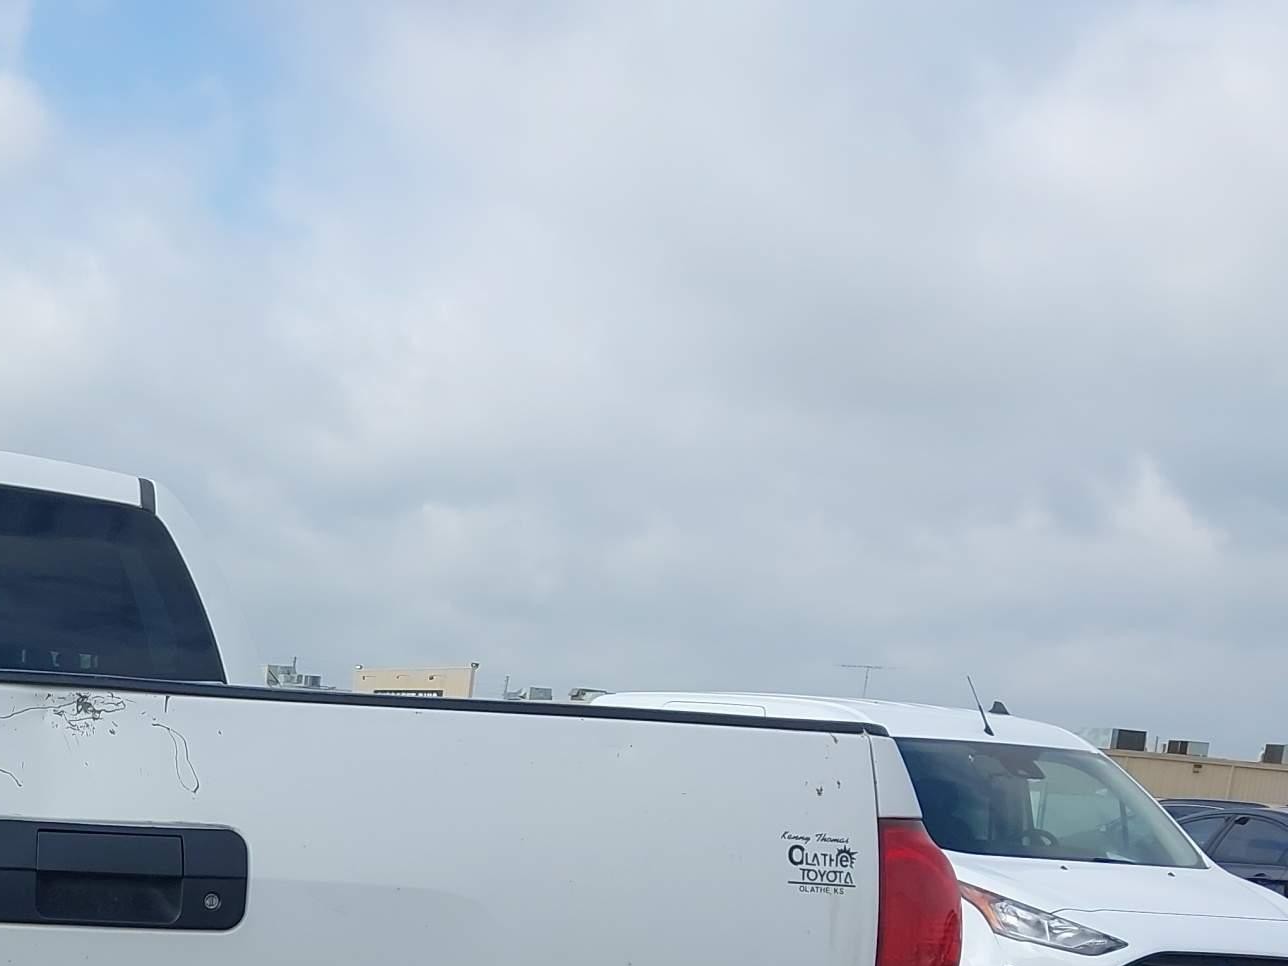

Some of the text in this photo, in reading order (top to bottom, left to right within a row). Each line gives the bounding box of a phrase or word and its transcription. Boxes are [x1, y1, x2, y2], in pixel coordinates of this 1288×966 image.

[780, 831, 849, 844] Kenny Thomas
[799, 868, 854, 884] TOYOTA
[833, 887, 845, 895] KS
